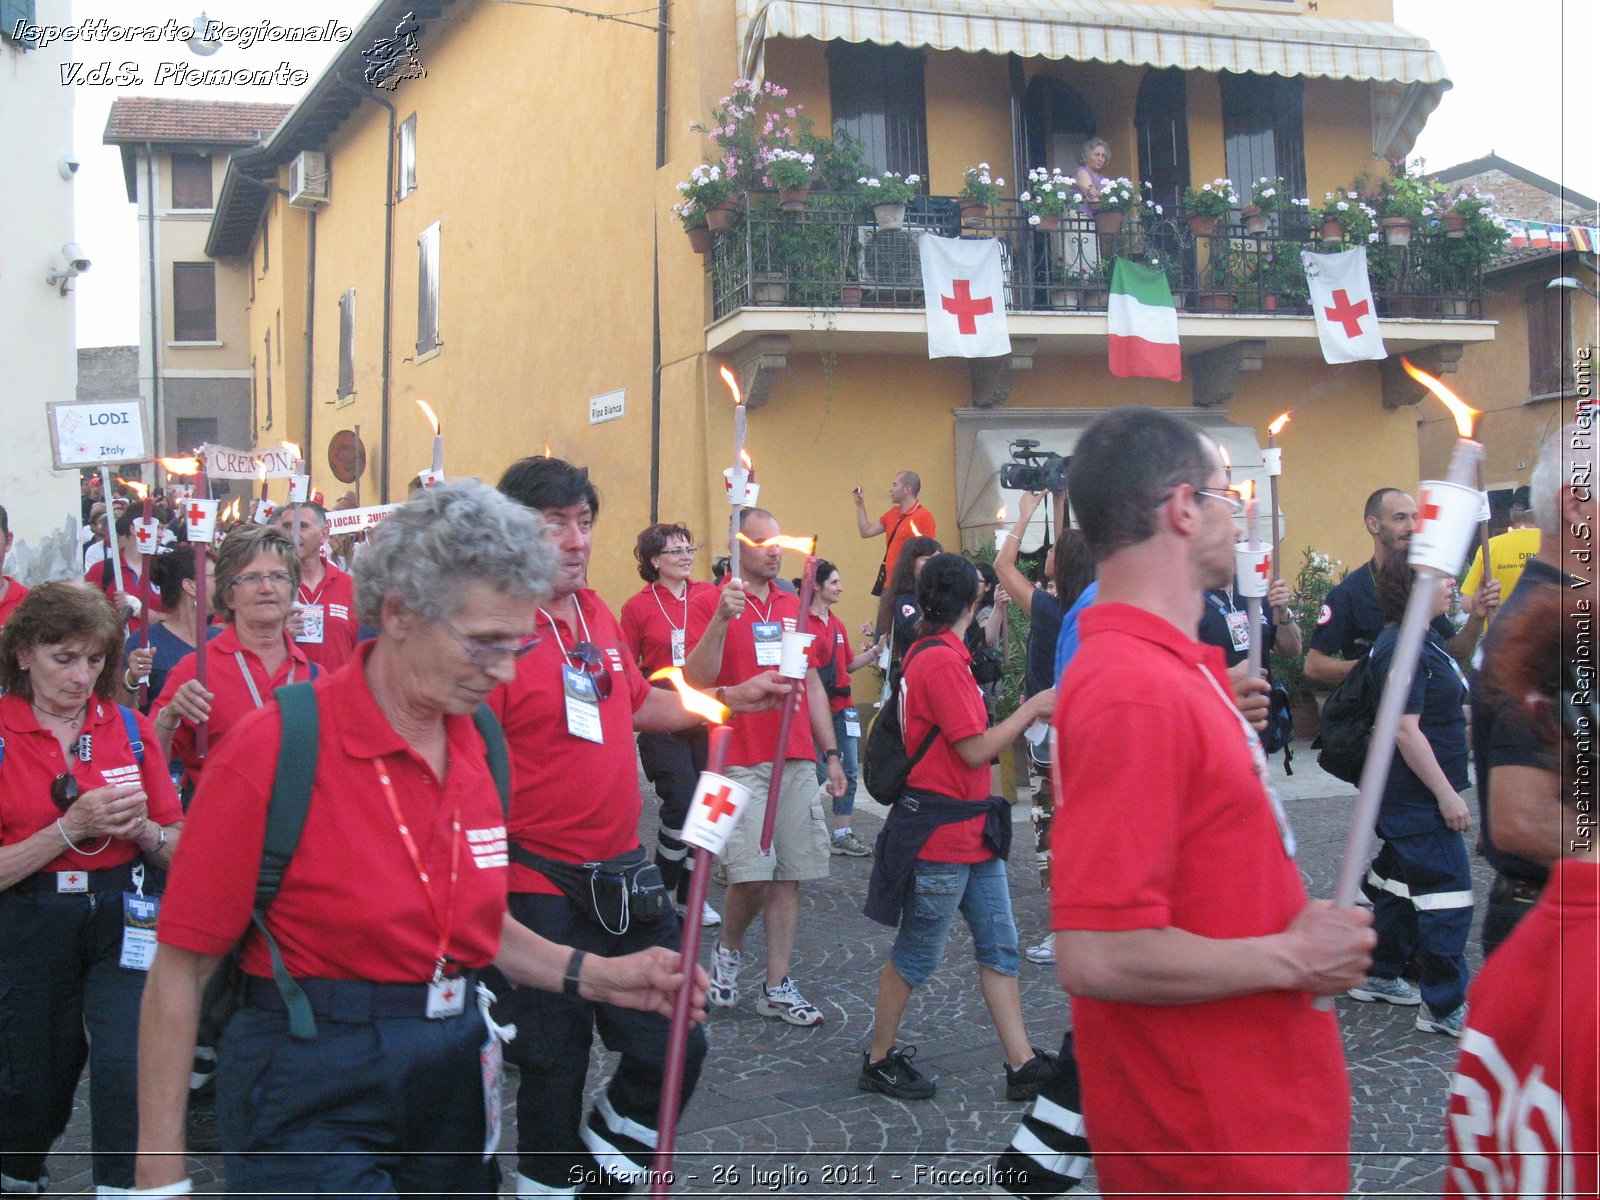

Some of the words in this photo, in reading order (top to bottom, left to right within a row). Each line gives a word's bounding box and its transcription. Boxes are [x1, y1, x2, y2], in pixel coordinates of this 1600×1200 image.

[592, 408, 603, 419] Ripa
[604, 404, 622, 416] Bianca
[89, 412, 129, 426] LODI
[100, 445, 126, 456] Italy
[334, 515, 361, 528] LOCALE
